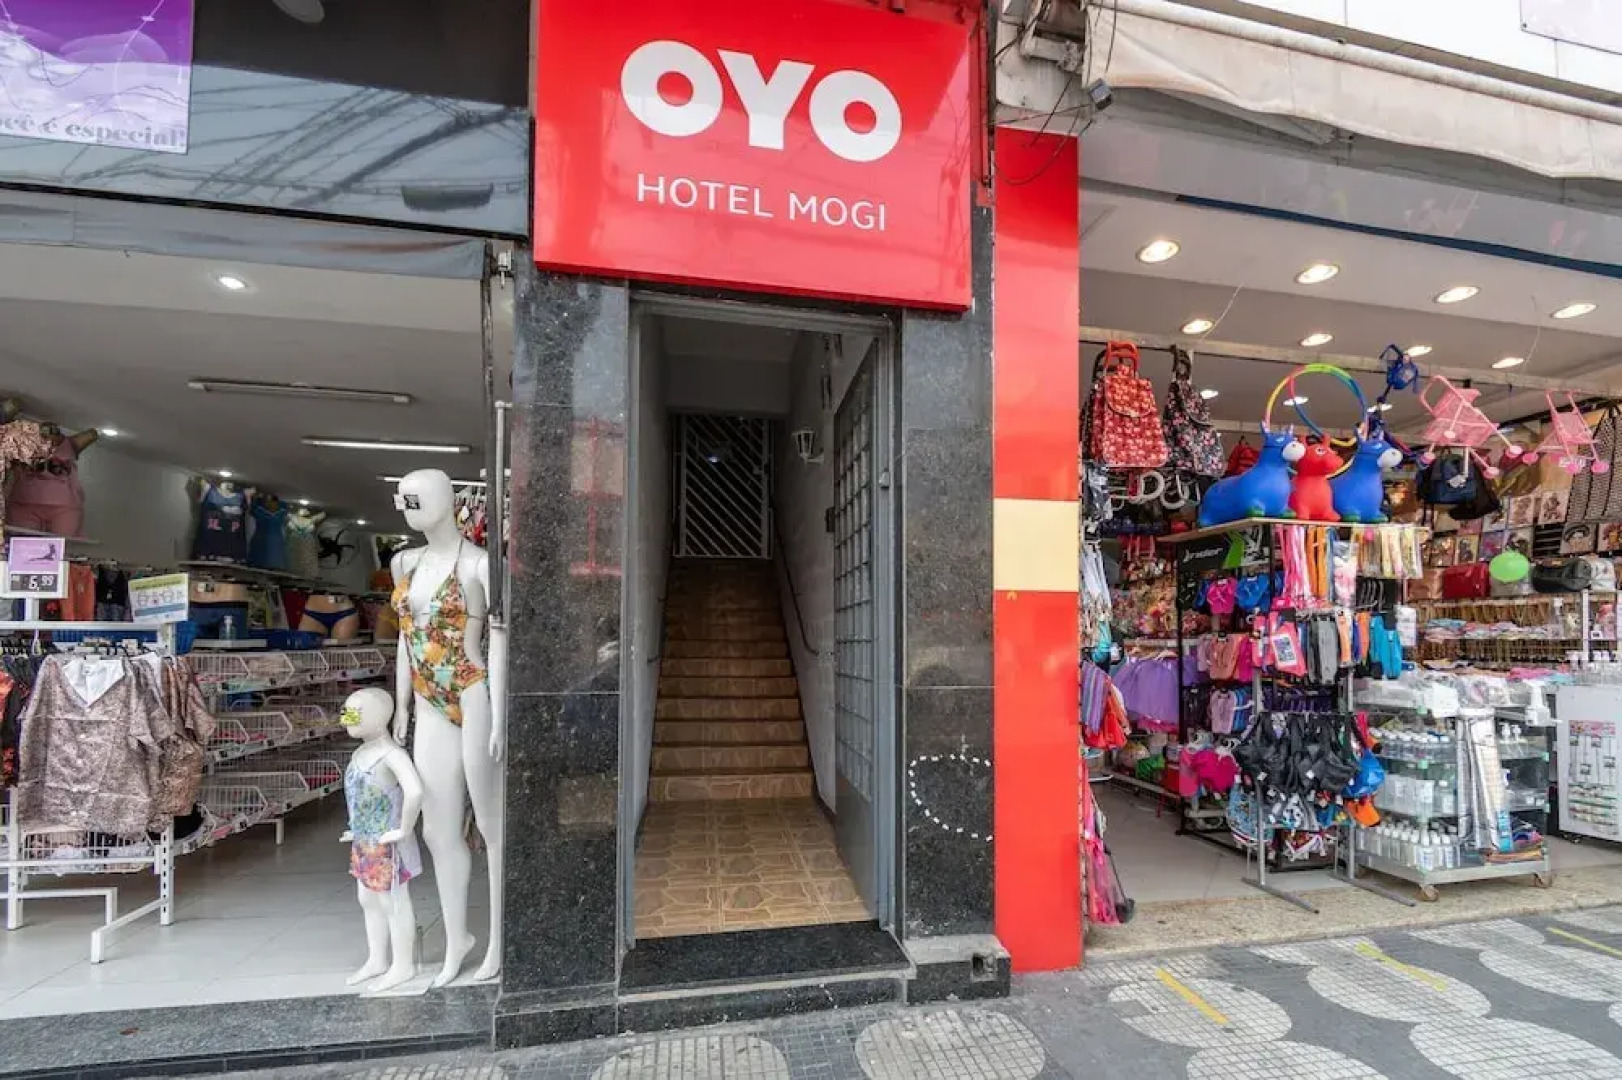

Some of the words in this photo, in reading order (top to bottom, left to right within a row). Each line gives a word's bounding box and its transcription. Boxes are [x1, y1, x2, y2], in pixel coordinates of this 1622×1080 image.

[621, 40, 902, 162] OYO
[65, 123, 186, 147] especial!
[636, 173, 773, 218] HOTEL
[788, 192, 886, 231] MOGI
